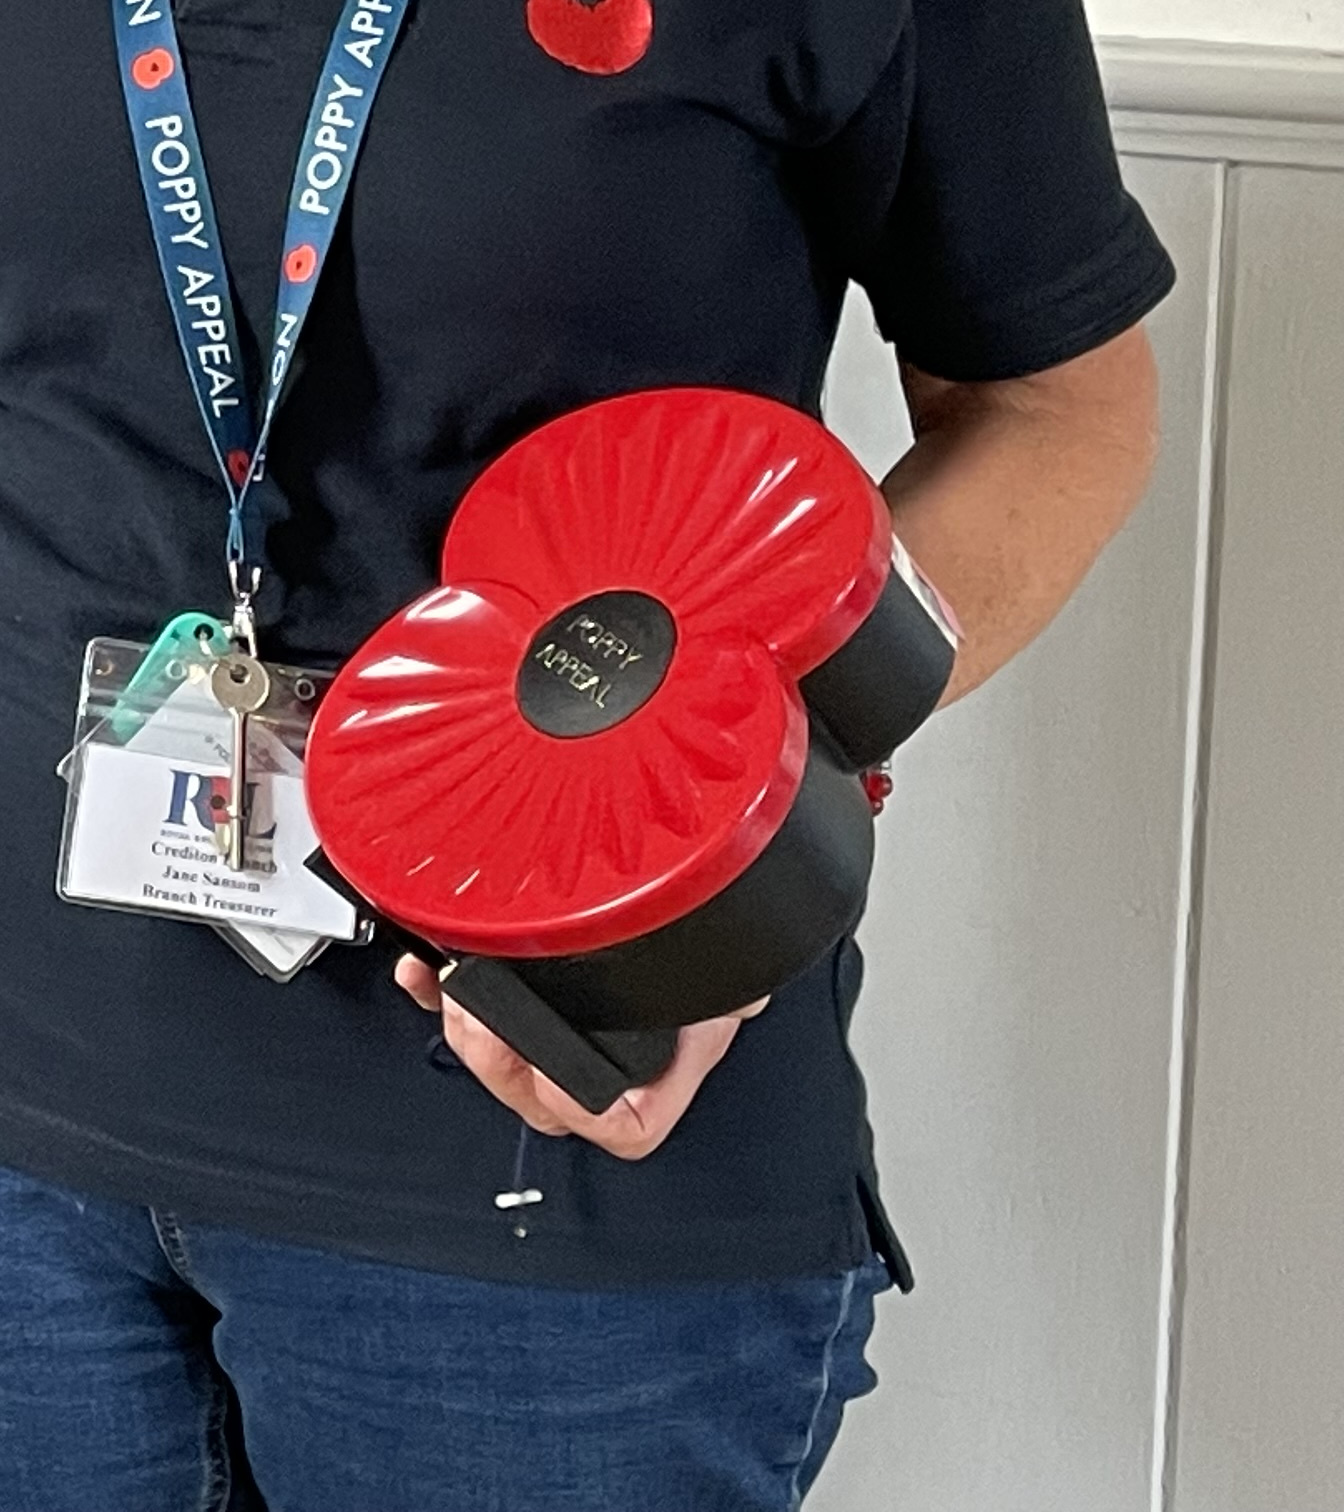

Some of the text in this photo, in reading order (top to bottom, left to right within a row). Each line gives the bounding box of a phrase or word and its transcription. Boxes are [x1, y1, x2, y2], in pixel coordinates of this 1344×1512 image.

[299, 73, 364, 215] POPPY
[144, 114, 240, 418] POPPY APPEAL
[272, 313, 298, 386] ON
[567, 614, 643, 670] POPPY
[536, 643, 611, 709] APPEAL
[151, 840, 217, 864] Crediton
[162, 865, 198, 883] Jane
[142, 884, 278, 918] Branch Treasurer
